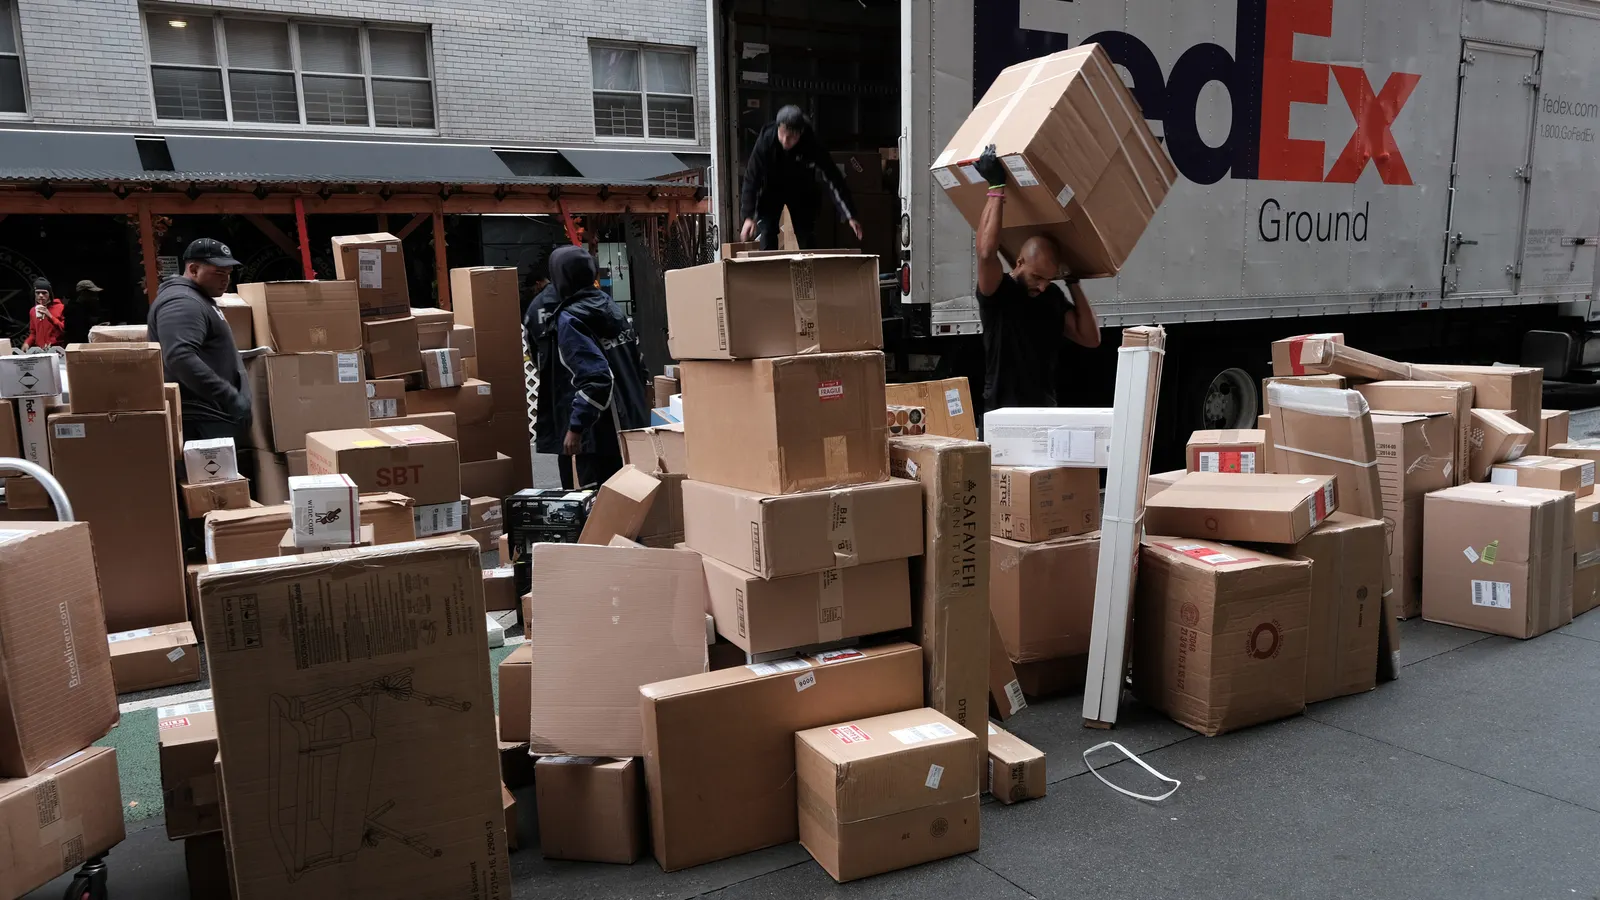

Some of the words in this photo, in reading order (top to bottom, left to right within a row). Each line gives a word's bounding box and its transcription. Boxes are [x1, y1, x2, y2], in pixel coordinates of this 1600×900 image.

[1542, 93, 1598, 118] fedex.com
[1540, 124, 1596, 142] 1.800.GoFedEx
[1258, 198, 1369, 242] Ground
[820, 386, 840, 395] FRAGILE
[376, 464, 424, 487] SBT
[840, 507, 848, 526] B.H.
[1020, 522, 1025, 532] S
[1084, 514, 1090, 524] S
[952, 480, 960, 589] FURNITURE
[962, 494, 976, 588] SAFAVIEH
[58, 601, 79, 688] Brooklinen.com
[958, 698, 966, 726] DTB9
[486, 821, 495, 855] F2906-13
